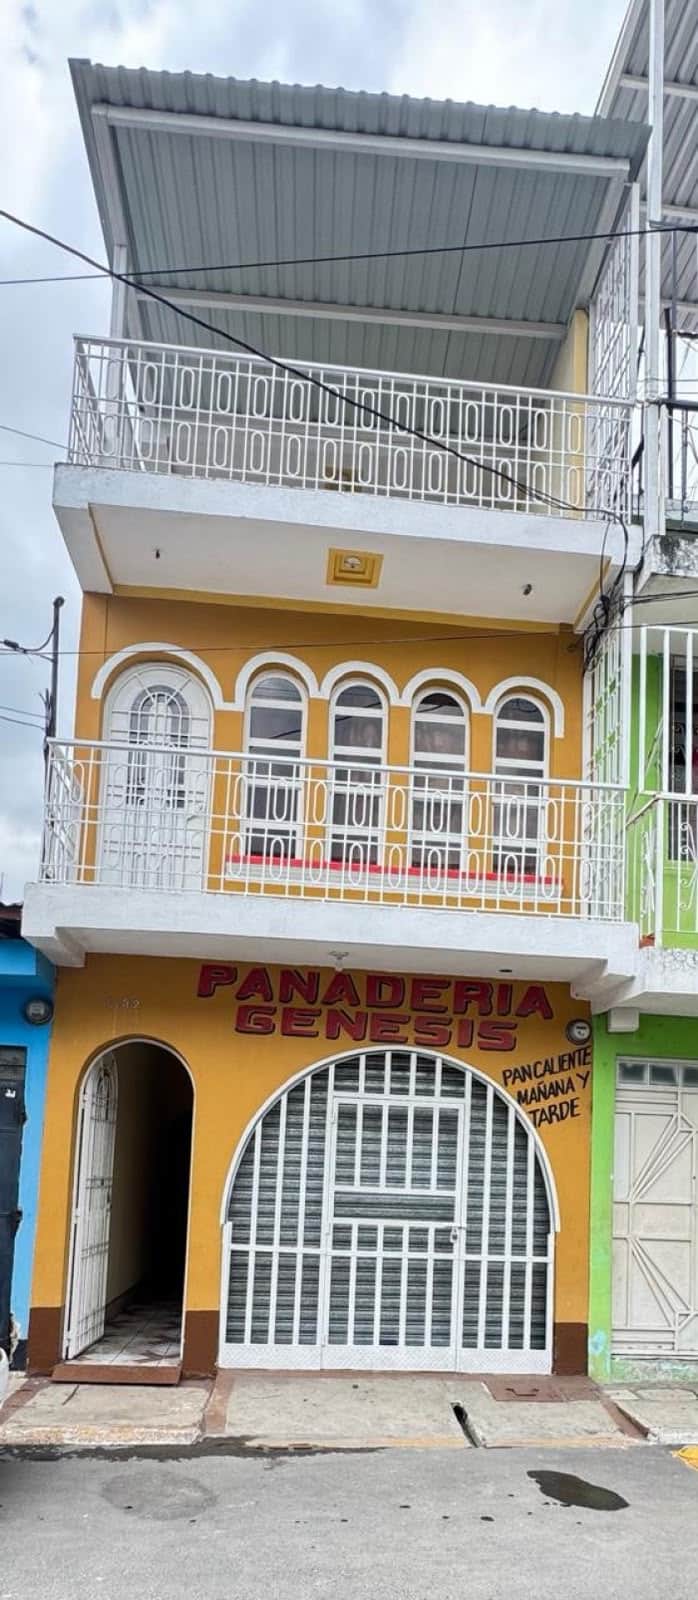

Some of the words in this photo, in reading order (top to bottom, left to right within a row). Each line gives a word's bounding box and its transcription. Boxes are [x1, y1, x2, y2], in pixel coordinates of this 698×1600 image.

[197, 964, 554, 1020] PANADERIA
[235, 1004, 517, 1052] GENESIS
[502, 1064, 532, 1087] PAN
[533, 1046, 592, 1078] CALIENTE
[516, 1077, 575, 1106] MAÑANA
[575, 1070, 590, 1089] Y
[528, 1097, 581, 1128] TARDE
